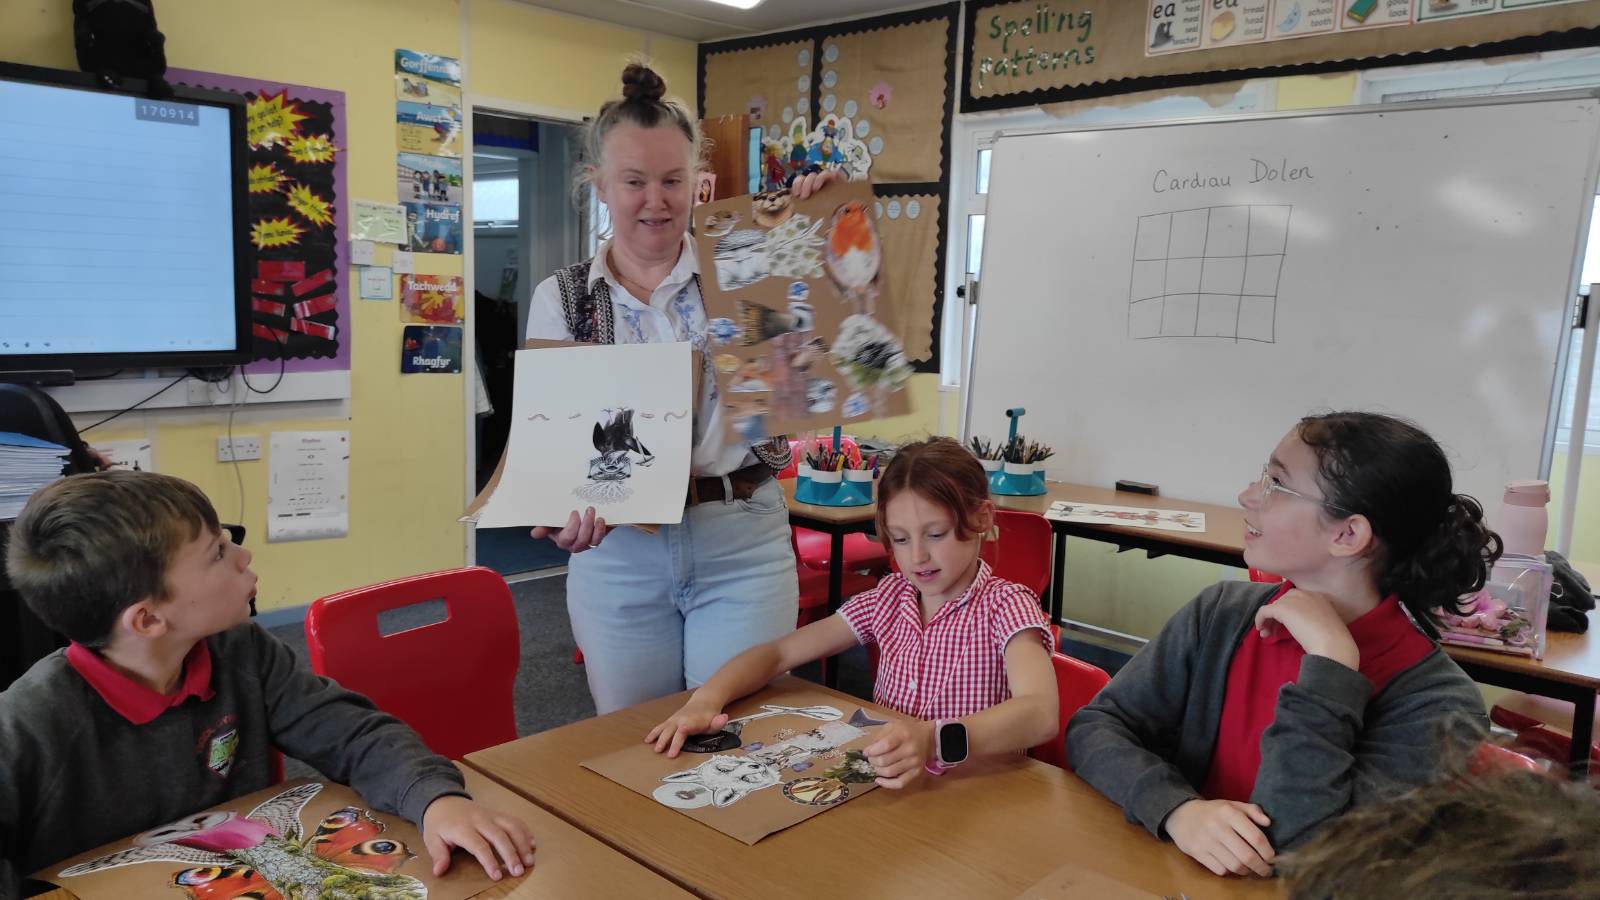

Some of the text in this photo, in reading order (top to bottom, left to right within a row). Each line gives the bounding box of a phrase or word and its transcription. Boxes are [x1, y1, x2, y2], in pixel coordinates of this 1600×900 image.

[1153, 3, 1175, 19] ea
[989, 3, 1093, 54] Spelling
[977, 45, 1095, 89] patterns
[141, 104, 195, 120] 170914
[1153, 158, 1314, 193] Cardiau Dolen
[426, 207, 460, 223] Hydref
[408, 281, 457, 292] Tachwedd
[413, 356, 451, 368] Rhagfyr
